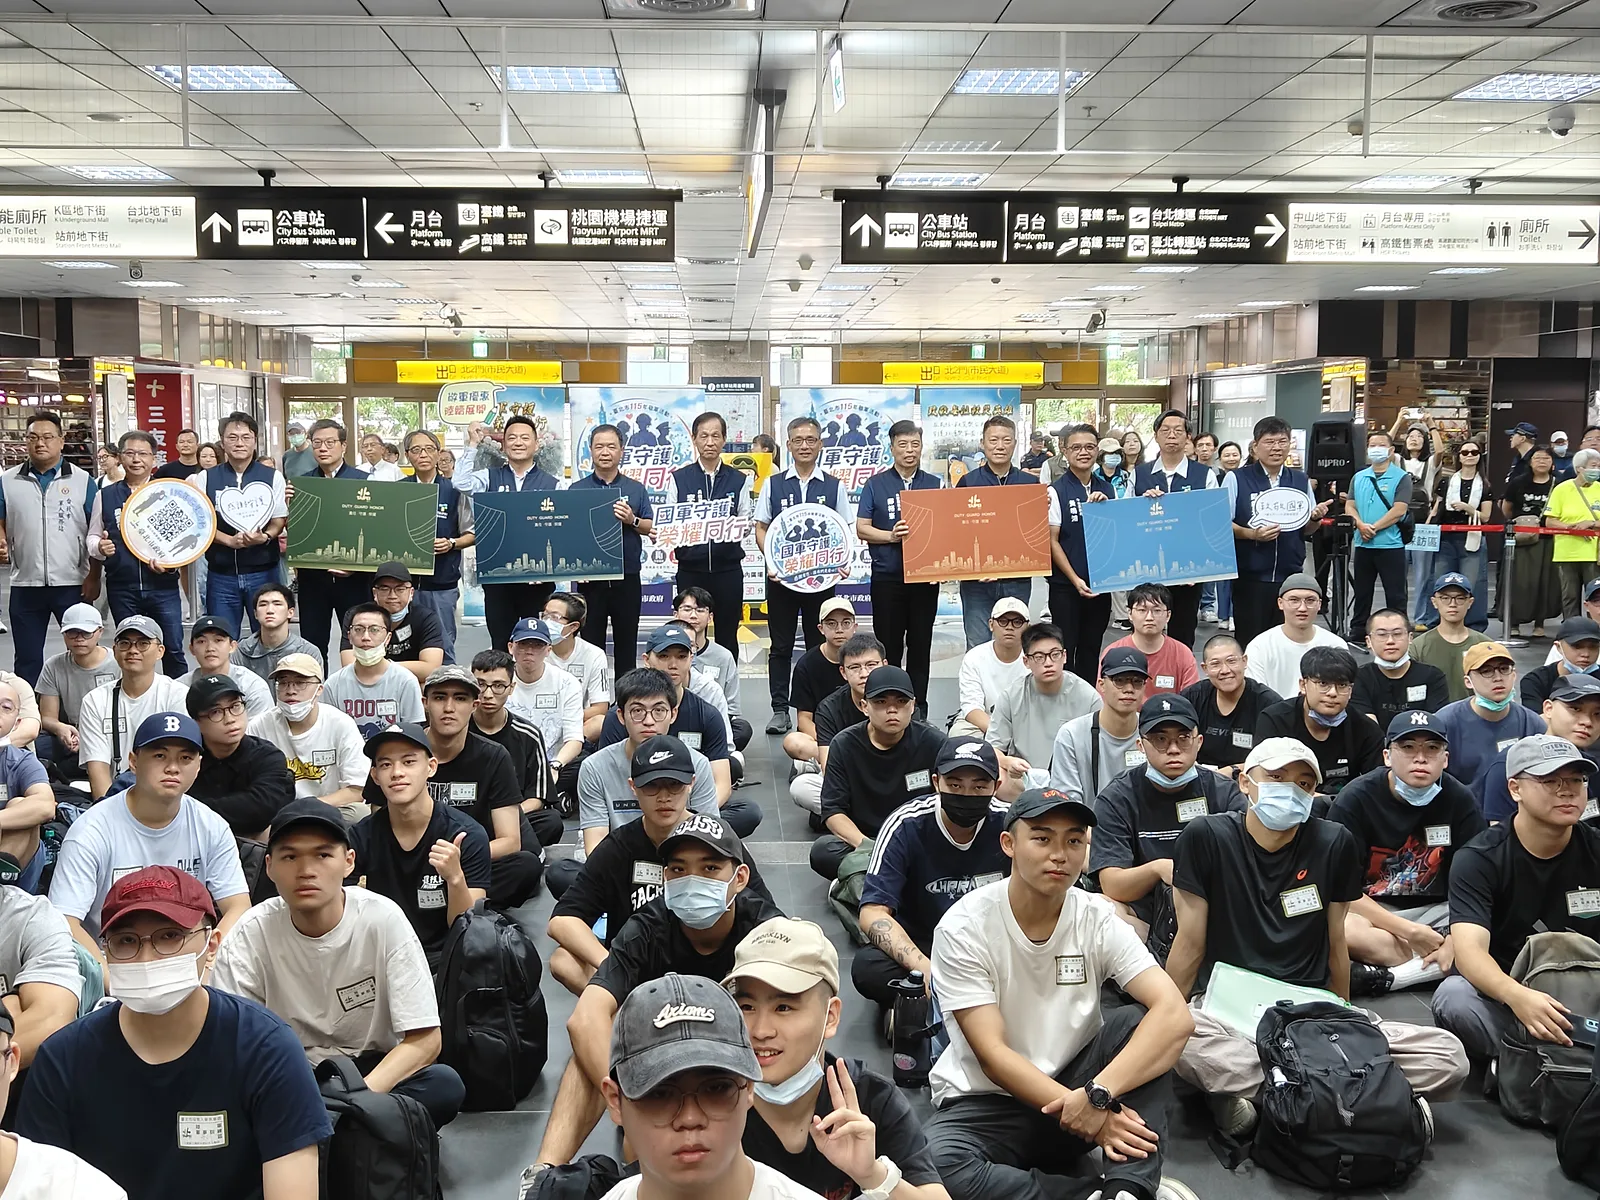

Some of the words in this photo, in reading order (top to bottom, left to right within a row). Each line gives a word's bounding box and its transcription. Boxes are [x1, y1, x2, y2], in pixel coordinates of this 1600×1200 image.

[54, 205, 106, 216] K區地下街
[127, 205, 182, 217] 台北地下街
[1152, 208, 1197, 221] 台北捷運
[127, 217, 147, 225] Taipei
[148, 217, 157, 225] City
[276, 210, 325, 227] 公車站
[411, 210, 443, 227] 月台
[571, 209, 668, 226] 桃園機場捷運
[921, 213, 969, 230] 公車站
[1014, 213, 1046, 230] 月台
[1293, 212, 1346, 223] 中山地下街
[1381, 212, 1425, 223] 月台專用
[14, 227, 38, 235] Toilet
[1152, 221, 1168, 229] Taipei
[1293, 223, 1322, 231] Zhongshan
[1519, 219, 1550, 234] 廁所
[55, 230, 109, 242] 站前地下街
[276, 227, 292, 236] City
[293, 227, 307, 236] Bus
[308, 227, 335, 236] Station
[411, 229, 443, 237] Platform
[571, 227, 608, 237] Taoyuan
[609, 227, 638, 238] Airport
[640, 227, 659, 236] MRT
[921, 230, 936, 241] City
[937, 230, 950, 239] Bus
[951, 230, 978, 239] Station
[1014, 232, 1046, 241] Platform
[481, 233, 504, 246] 高鐵
[1080, 236, 1103, 249] 高鐵
[1151, 236, 1206, 249] 臺北轉運站
[1293, 239, 1346, 250] 站前地下街
[1380, 238, 1434, 249] 高鐵售票處
[1519, 235, 1541, 243] Toilet
[436, 364, 457, 380] 出口
[920, 365, 941, 381] 出口
[817, 446, 883, 468] 軍守護
[654, 500, 730, 526] 國軍守護
[657, 517, 748, 548] 榮耀同行
[781, 536, 830, 559] 國軍守護
[757, 554, 763, 563] 分
[785, 547, 844, 574] 榮耀同行
[745, 586, 755, 595] 30
[757, 586, 763, 595] 分
[344, 699, 397, 724] ROO
[164, 715, 181, 732] B
[1411, 712, 1429, 725] NY
[954, 752, 983, 763] HONDA
[751, 932, 792, 944] BROOKLYN
